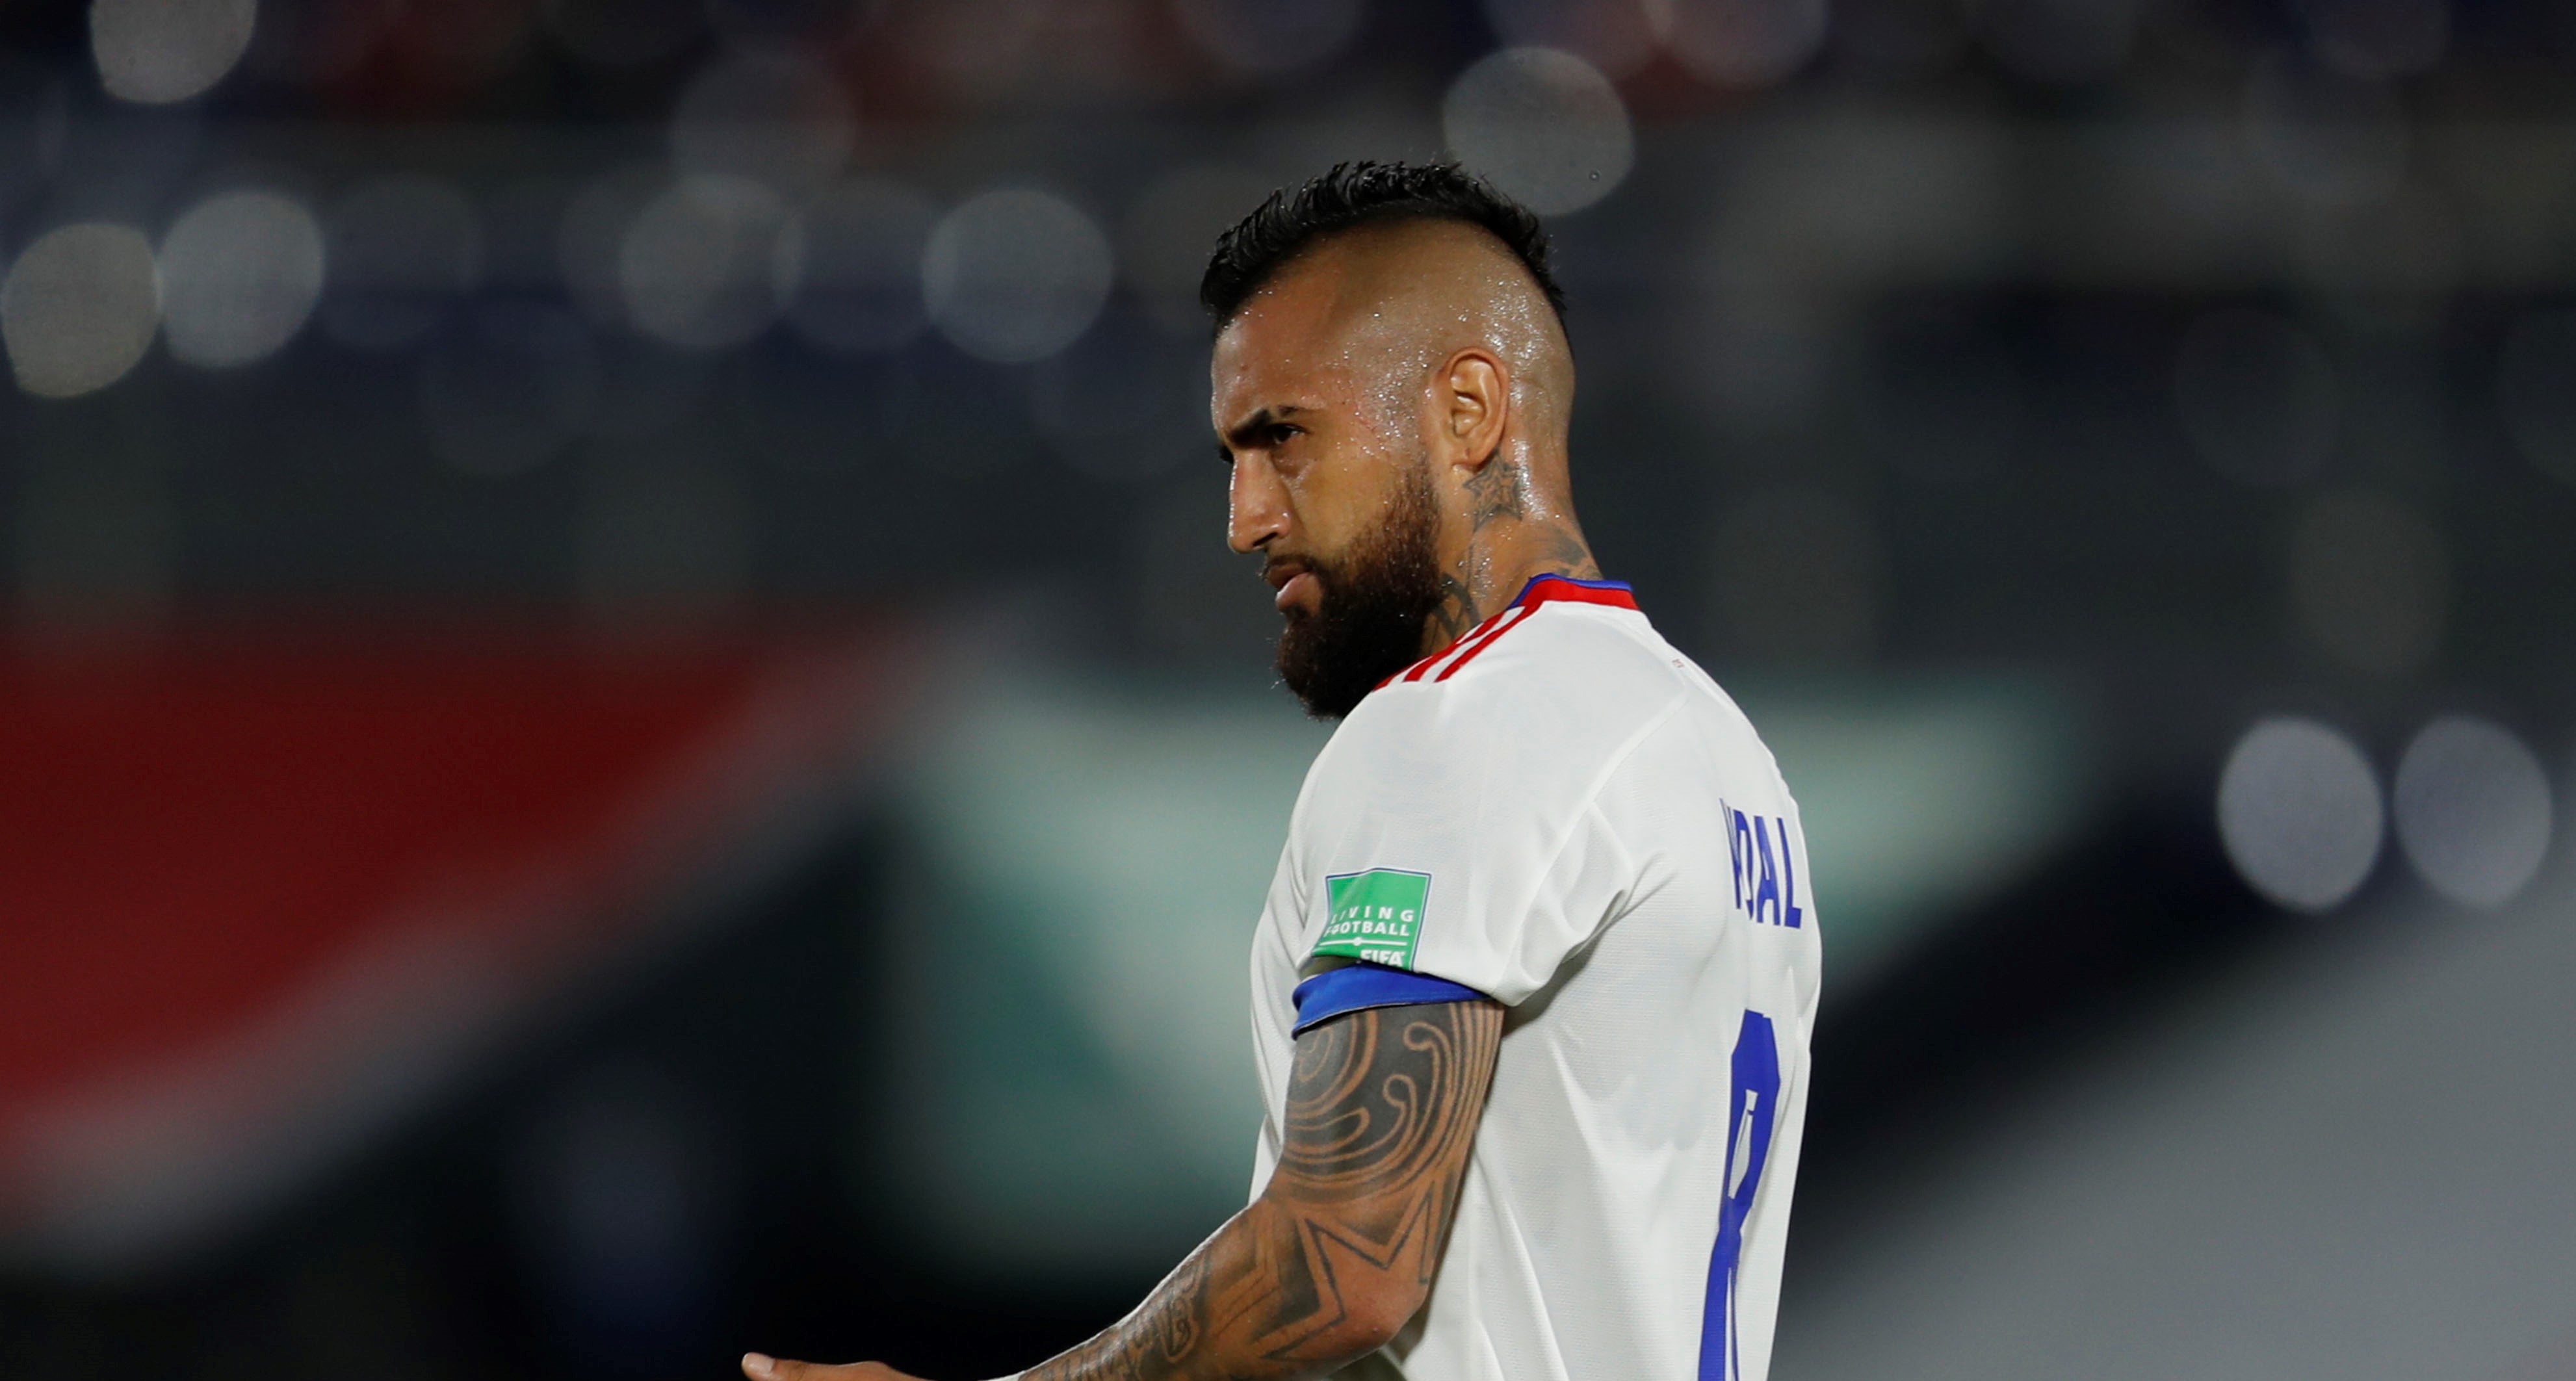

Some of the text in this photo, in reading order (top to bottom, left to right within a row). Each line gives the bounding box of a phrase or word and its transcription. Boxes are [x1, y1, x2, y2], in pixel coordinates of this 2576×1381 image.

[1331, 905, 1415, 924] LIVING
[1323, 920, 1410, 938] FOOTBALL
[1360, 949, 1405, 968] FIFA
[1697, 1008, 1781, 1381] 8
